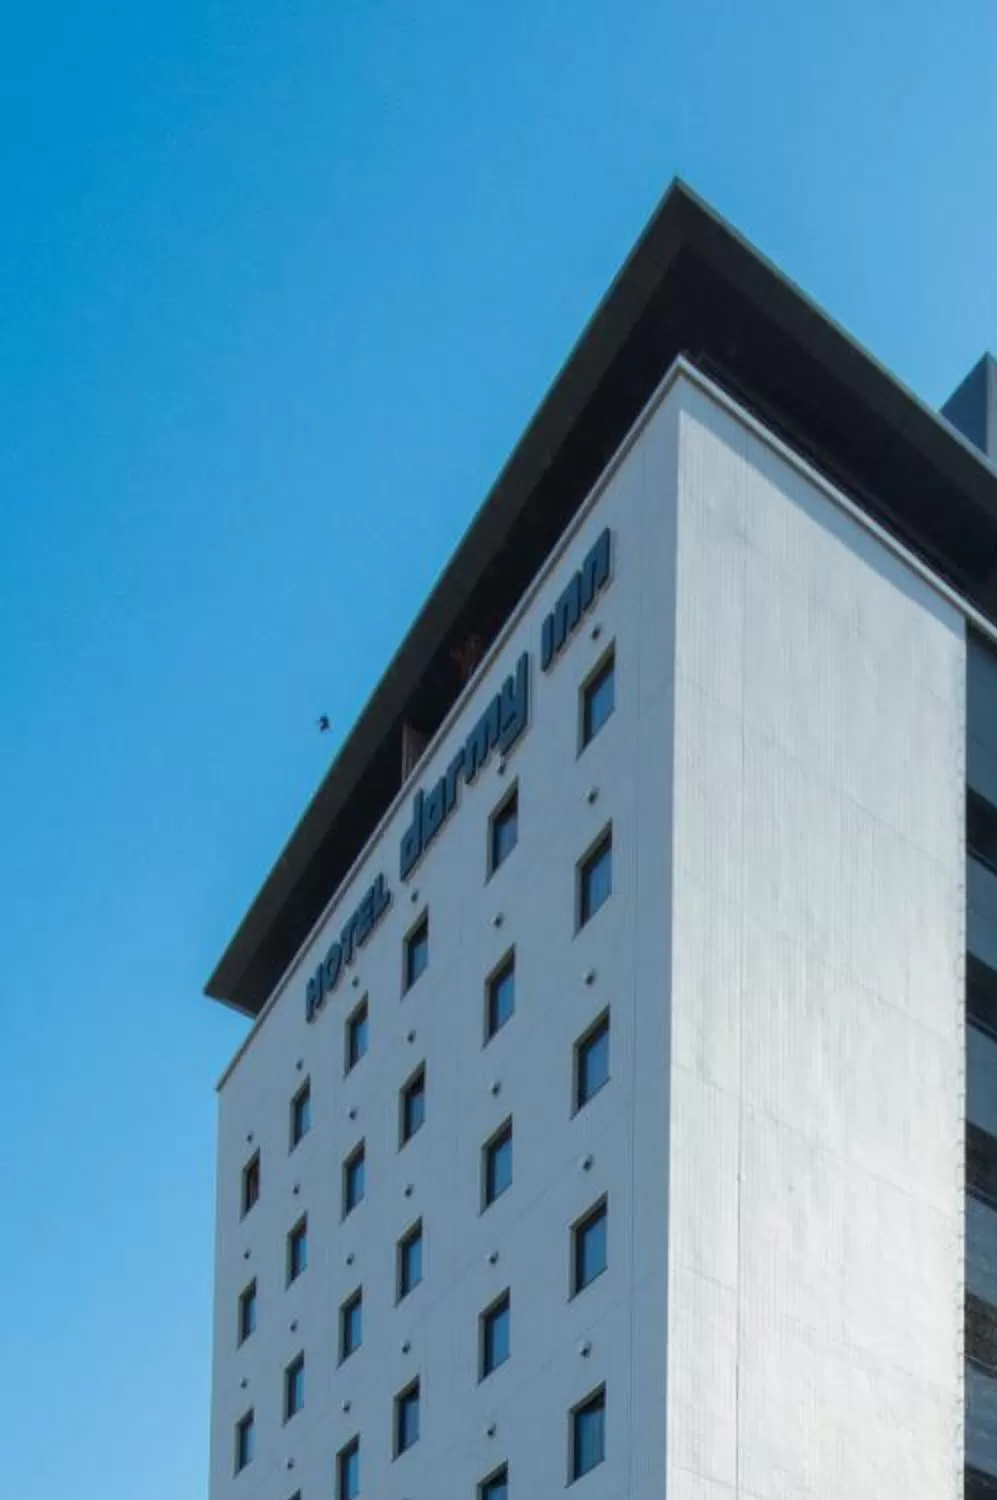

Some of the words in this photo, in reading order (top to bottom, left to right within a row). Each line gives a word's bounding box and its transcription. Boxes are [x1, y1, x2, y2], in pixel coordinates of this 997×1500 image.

[306, 872, 391, 1024] HOTEL
[400, 651, 529, 882] dormy
[542, 527, 611, 673] inn
